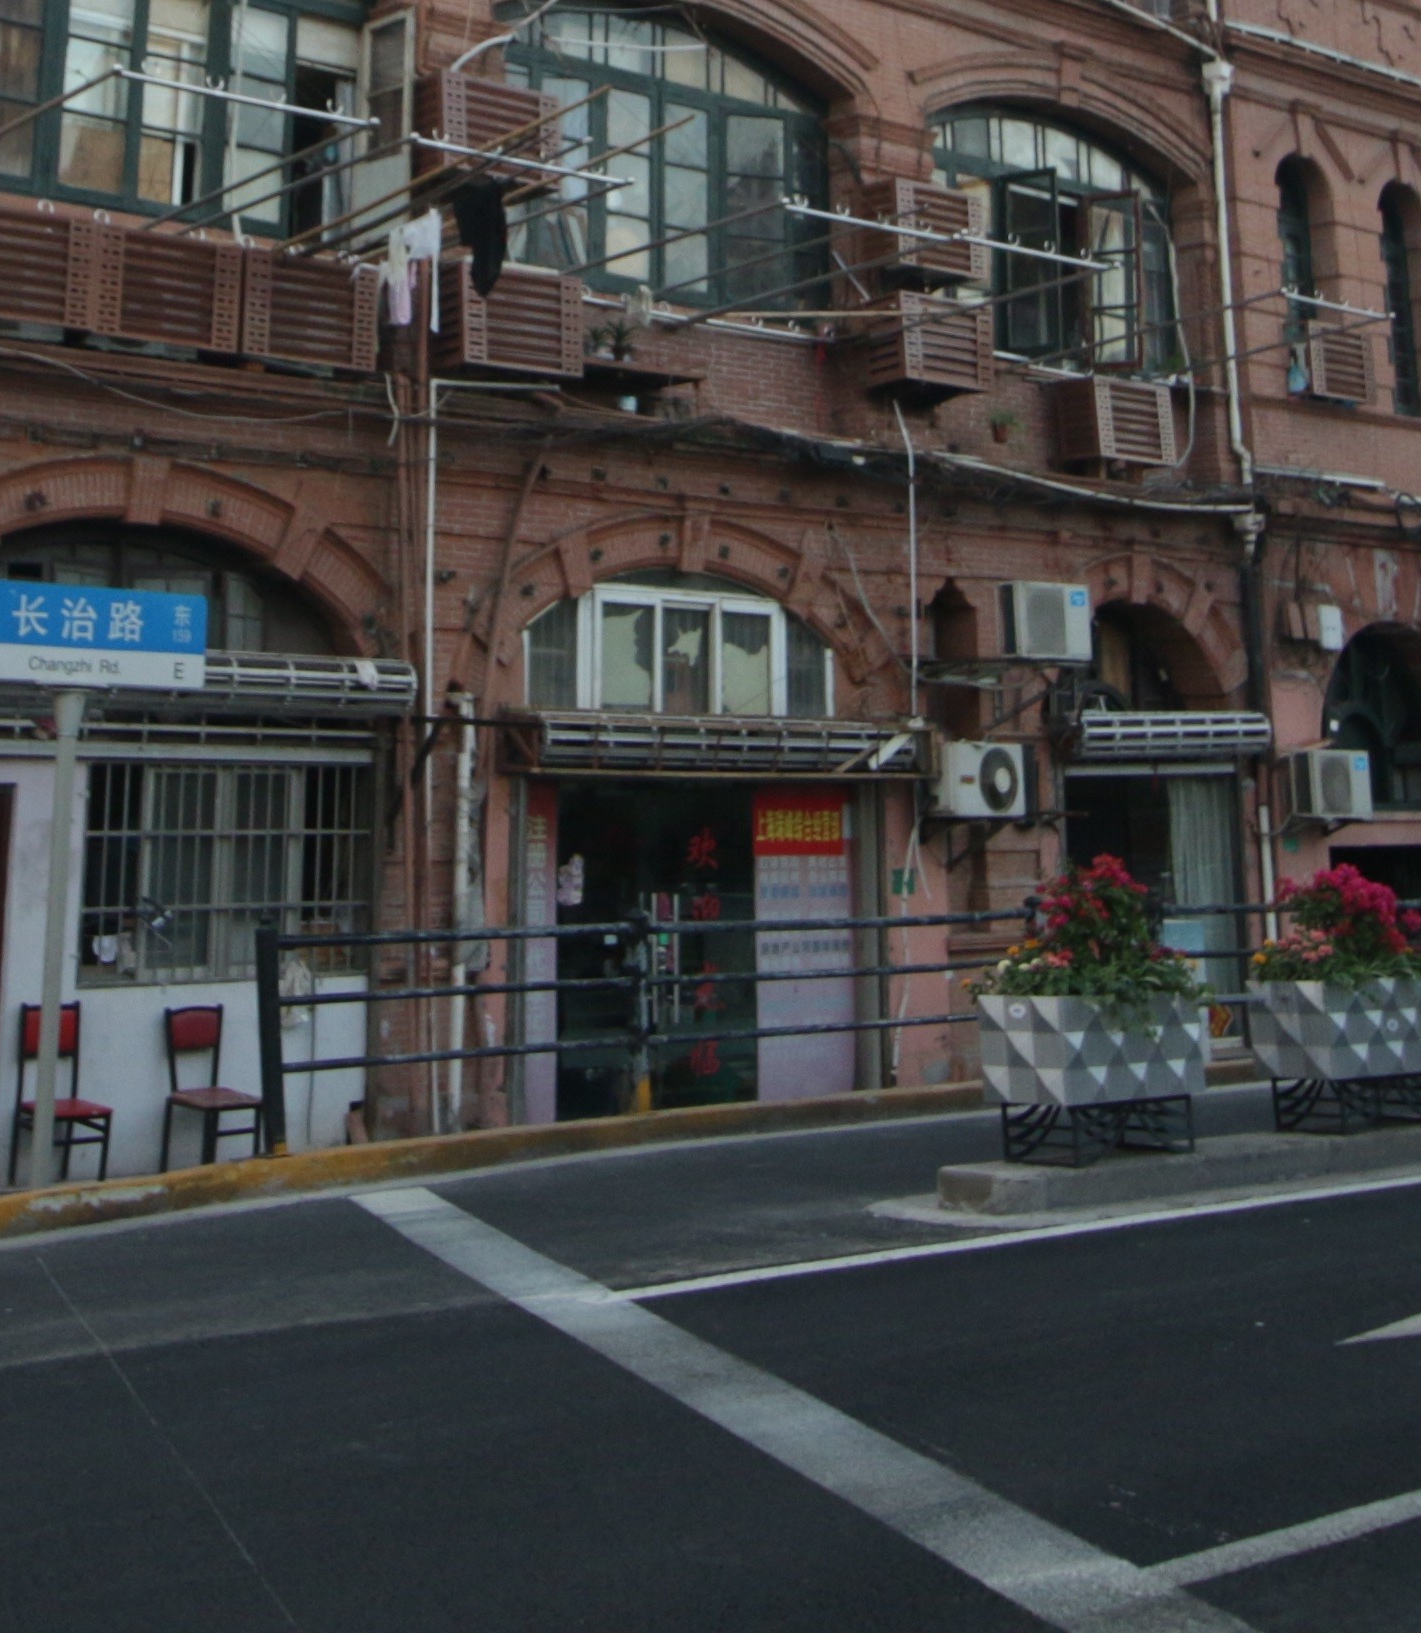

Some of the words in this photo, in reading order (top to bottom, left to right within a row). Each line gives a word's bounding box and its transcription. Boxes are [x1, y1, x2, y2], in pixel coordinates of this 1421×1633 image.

[11, 593, 144, 643] 长治路
[172, 604, 193, 627] 东
[28, 655, 93, 676] Changzhi
[98, 659, 121, 675] Rd.
[172, 661, 185, 680] E
